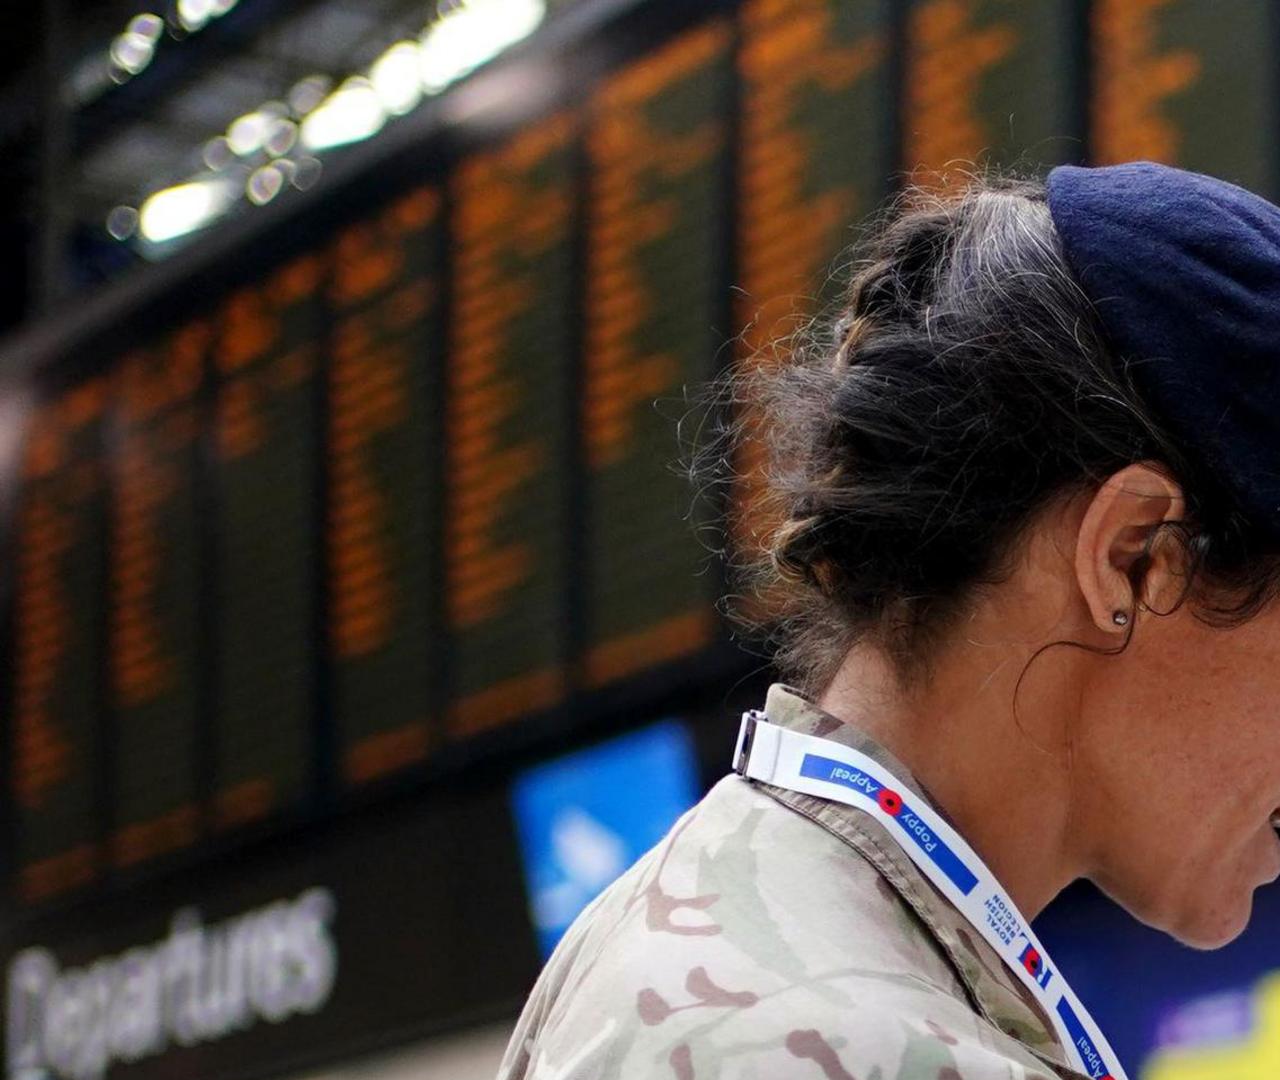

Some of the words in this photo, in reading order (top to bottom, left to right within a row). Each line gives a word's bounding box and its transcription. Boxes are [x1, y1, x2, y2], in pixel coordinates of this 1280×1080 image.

[830, 767, 879, 794] Appeal
[902, 813, 937, 853] Poppy
[984, 899, 1016, 938] BRITISH
[987, 914, 1011, 945] ROYAL
[993, 894, 1021, 931] LEGION
[1077, 1036, 1103, 1079] Appeal
